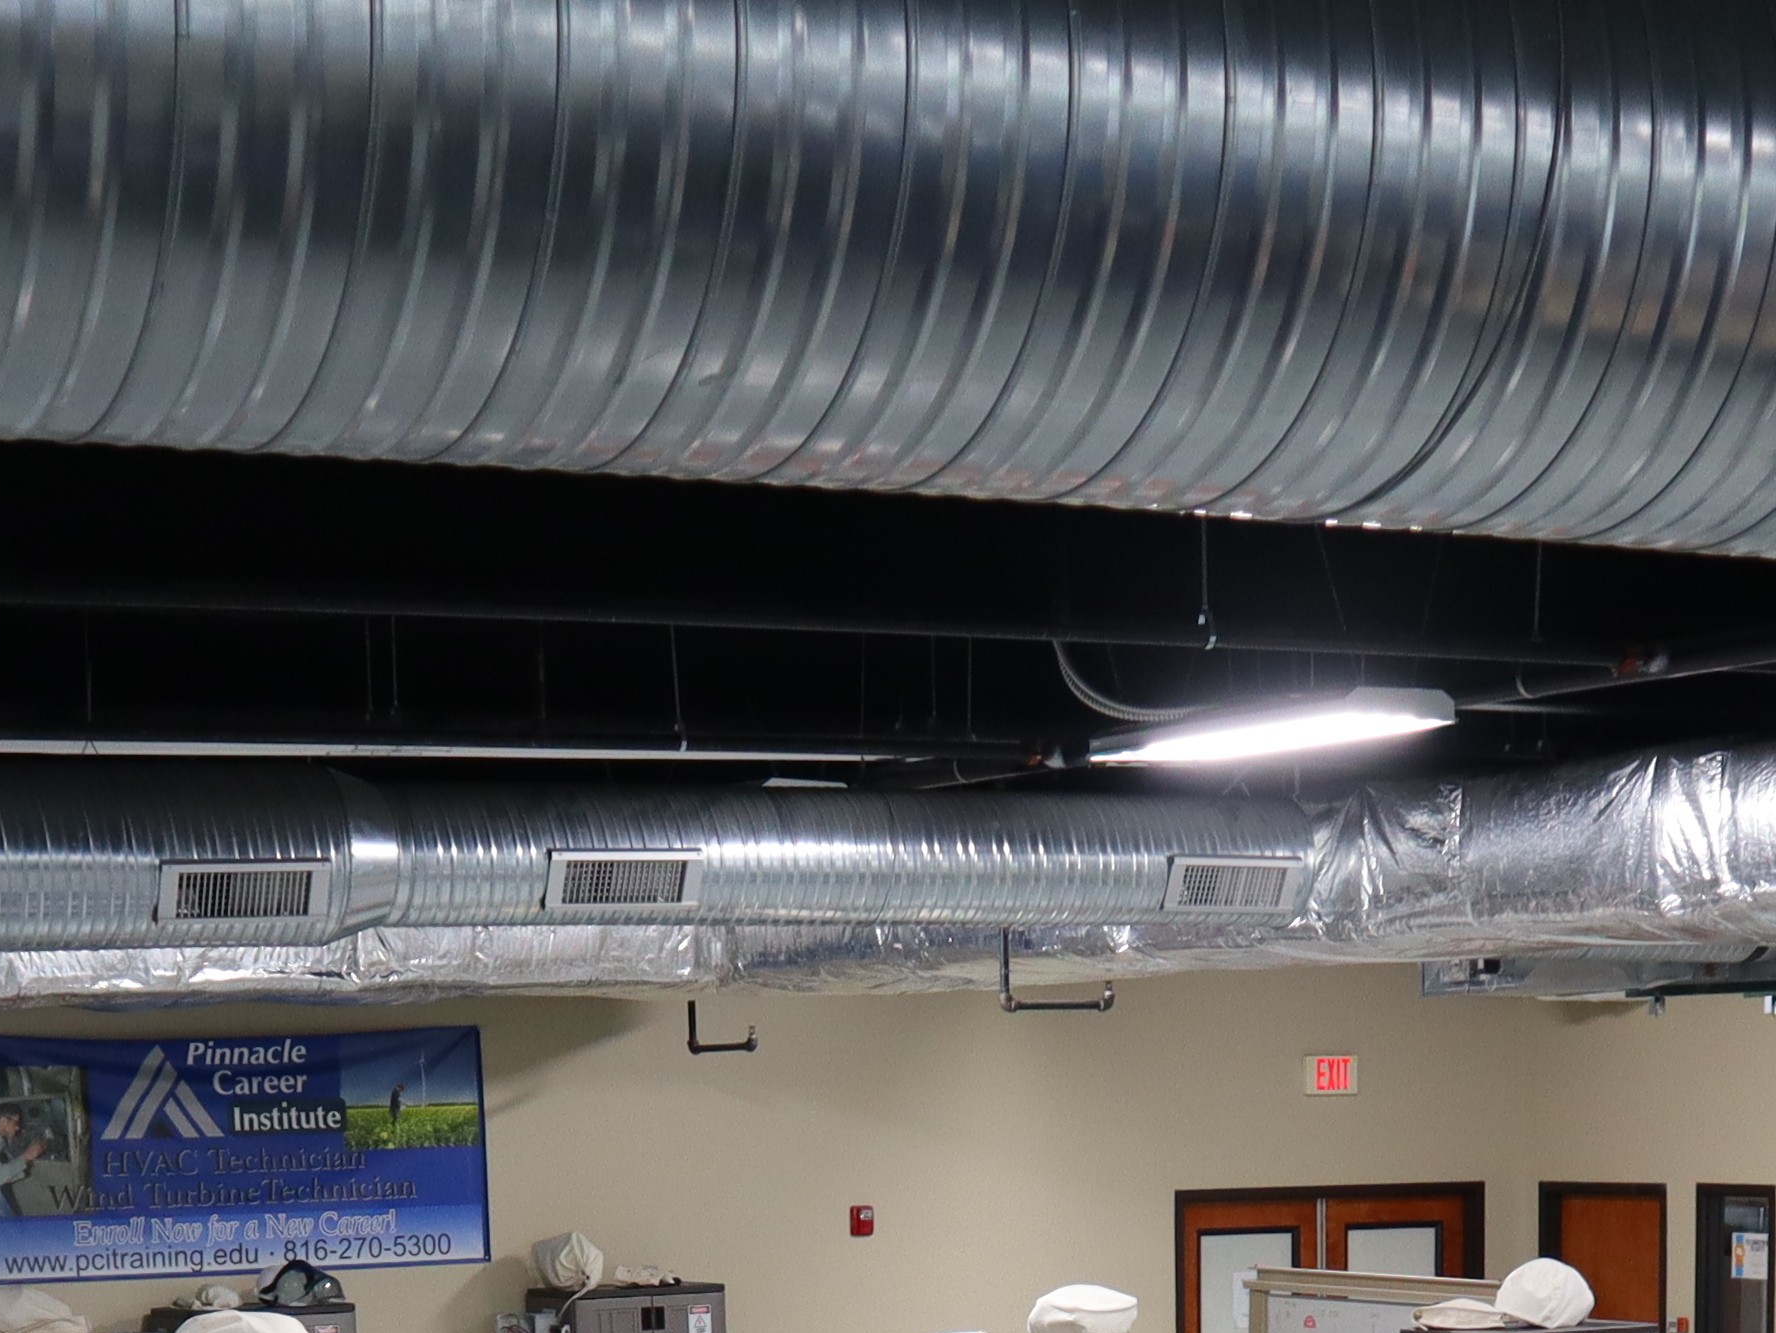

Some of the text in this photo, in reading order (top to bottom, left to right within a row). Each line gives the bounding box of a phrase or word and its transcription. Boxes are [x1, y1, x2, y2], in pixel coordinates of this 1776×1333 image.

[186, 1038, 307, 1066] Pinnacle
[212, 1069, 308, 1096] Career
[1316, 1057, 1351, 1090] EXIT
[233, 1101, 342, 1132] Institute
[101, 1147, 366, 1178] HVAC Technician
[47, 1176, 418, 1212] Wind Turbine Technician
[73, 1208, 397, 1248] Enroll Now for a New Career!
[4, 1233, 452, 1277] www.pcitraining.edu 816-270-5300
